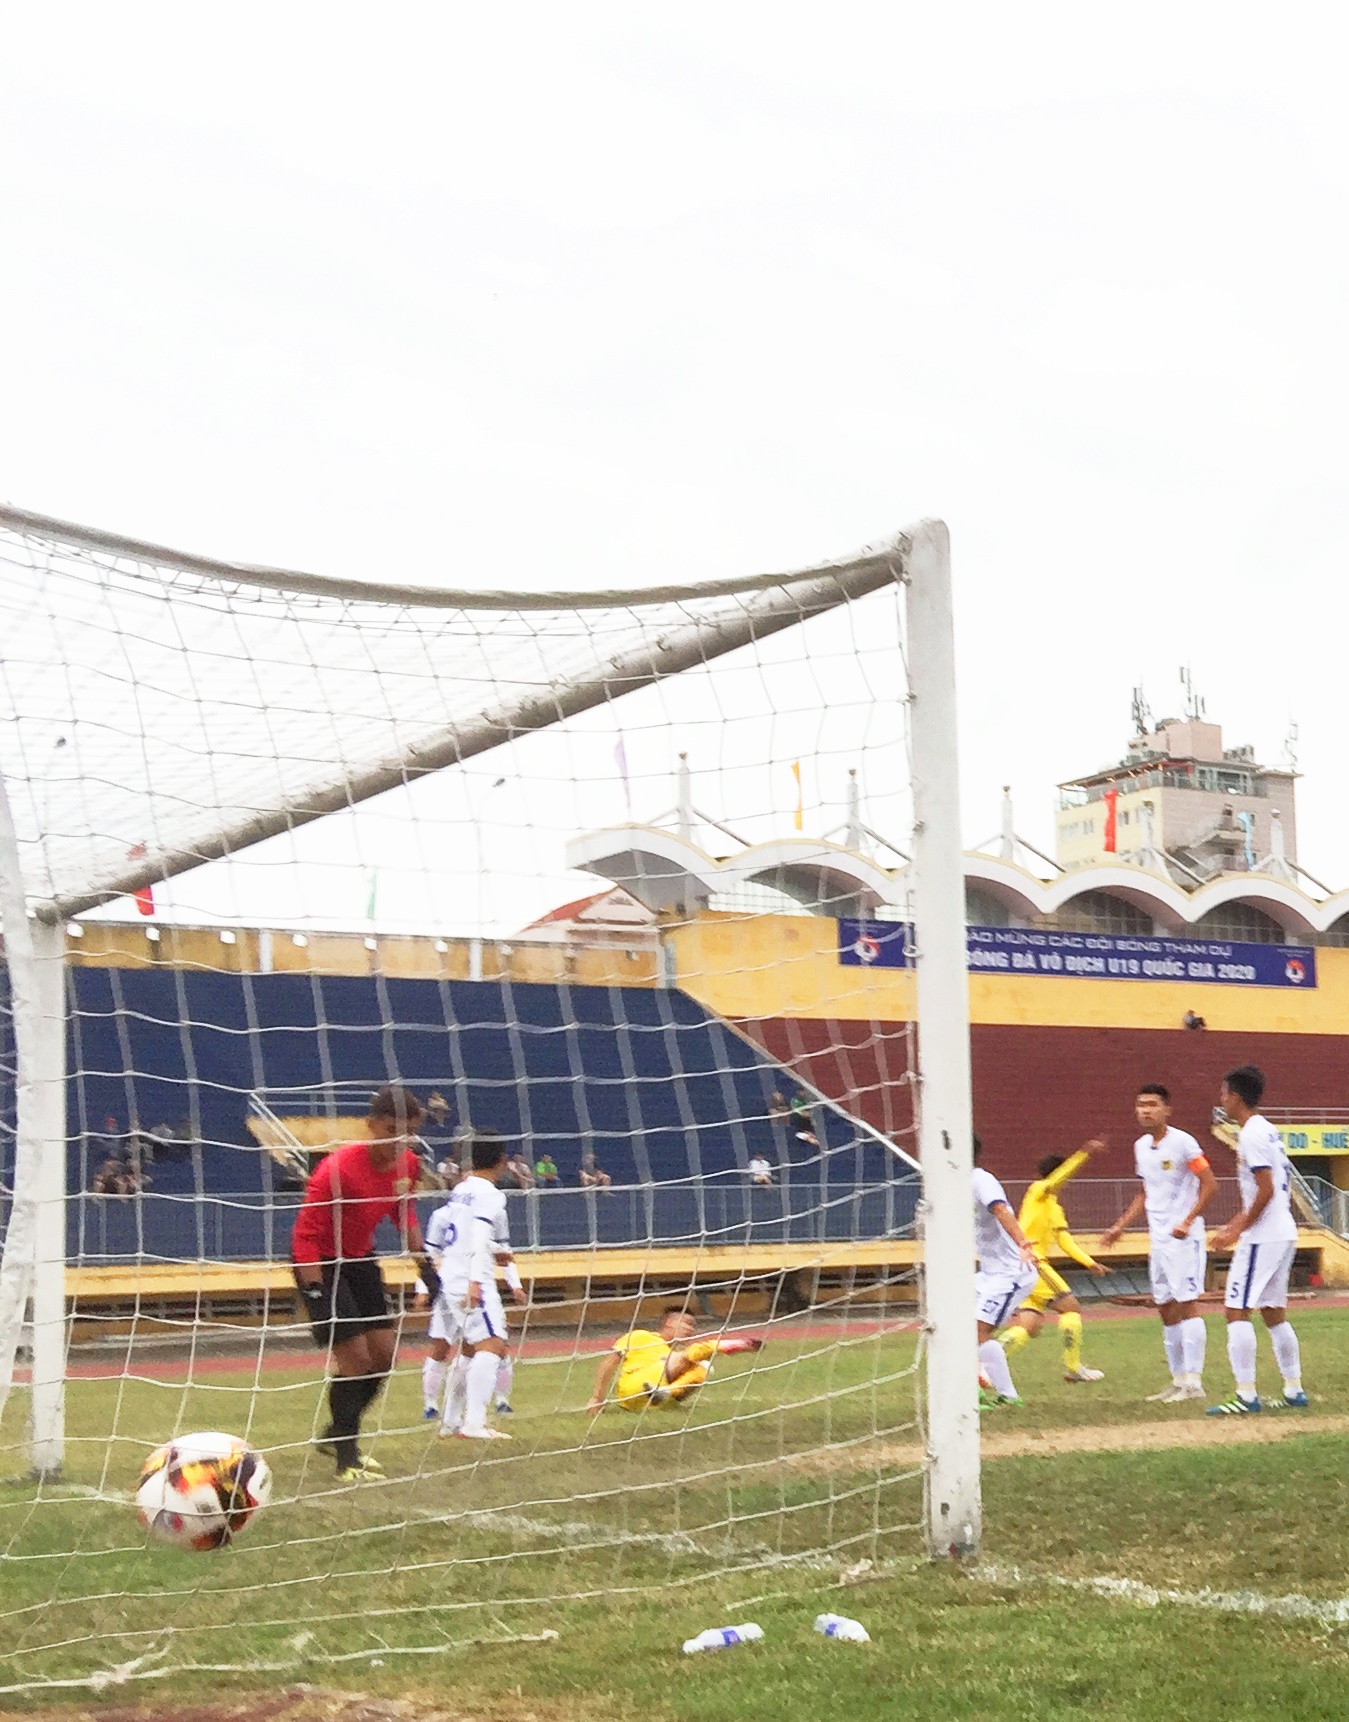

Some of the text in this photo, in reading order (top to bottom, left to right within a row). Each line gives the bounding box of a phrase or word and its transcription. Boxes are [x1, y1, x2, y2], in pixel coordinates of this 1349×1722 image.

[1048, 934, 1084, 948] CÁC
[1163, 942, 1208, 955] THAM
[1107, 957, 1140, 975] U19
[1142, 956, 1185, 977] QUỐC
[1187, 961, 1216, 978] GIA
[1217, 963, 1257, 980] 2020
[1229, 1281, 1240, 1299] 5
